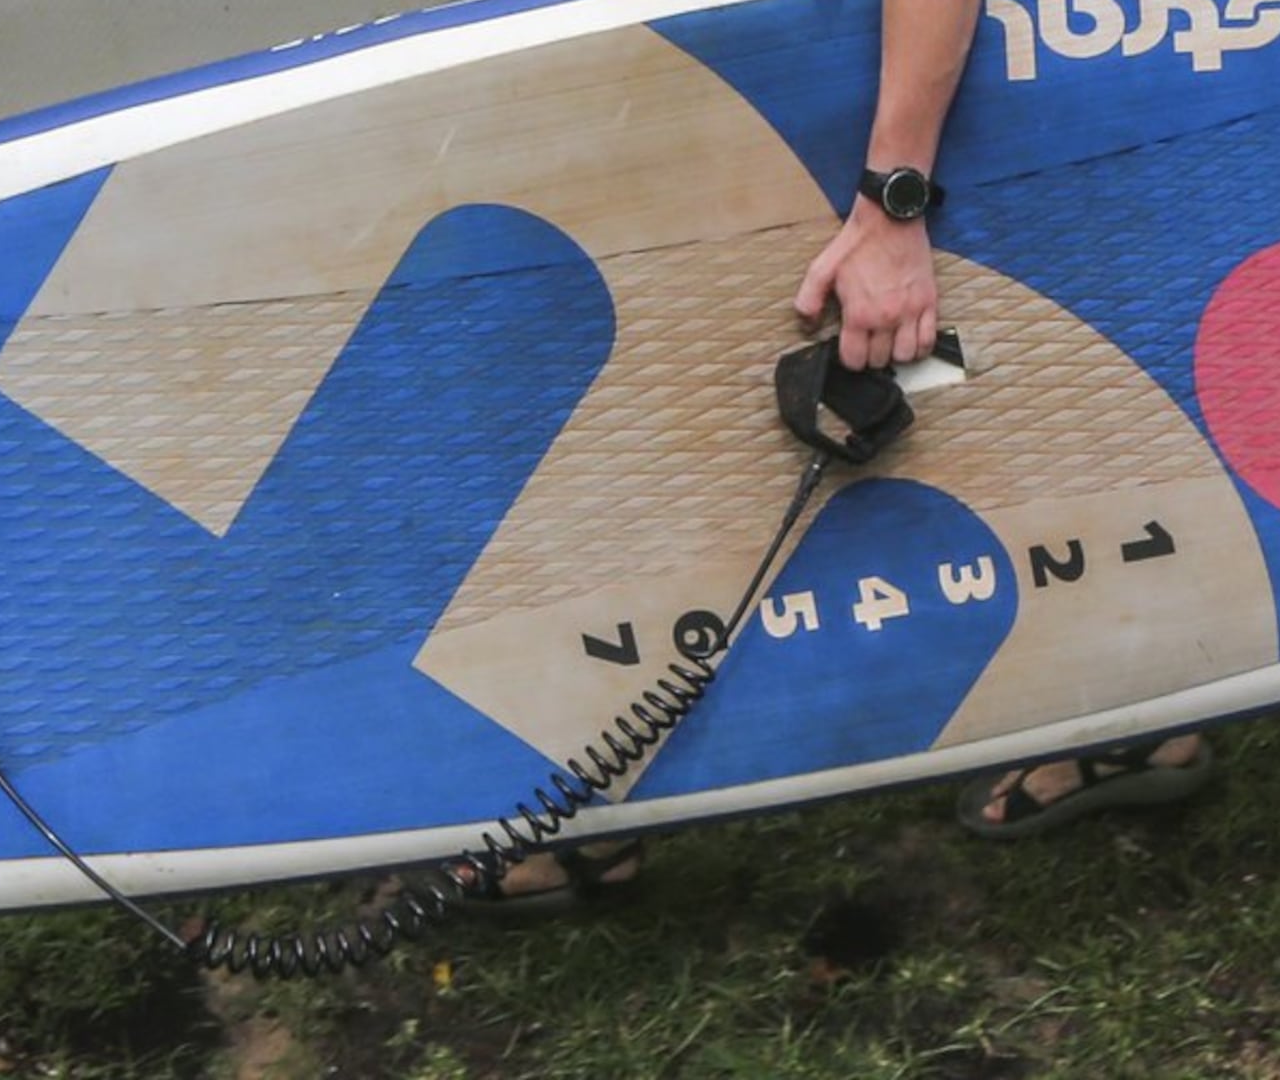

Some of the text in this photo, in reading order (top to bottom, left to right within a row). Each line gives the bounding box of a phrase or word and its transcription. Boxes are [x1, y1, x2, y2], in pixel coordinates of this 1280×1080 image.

[1028, 539, 1085, 589] 2
[1121, 520, 1176, 563] 1
[852, 575, 910, 632] 4
[938, 555, 997, 605] 3
[760, 590, 820, 639] 5
[581, 622, 641, 666] 7
